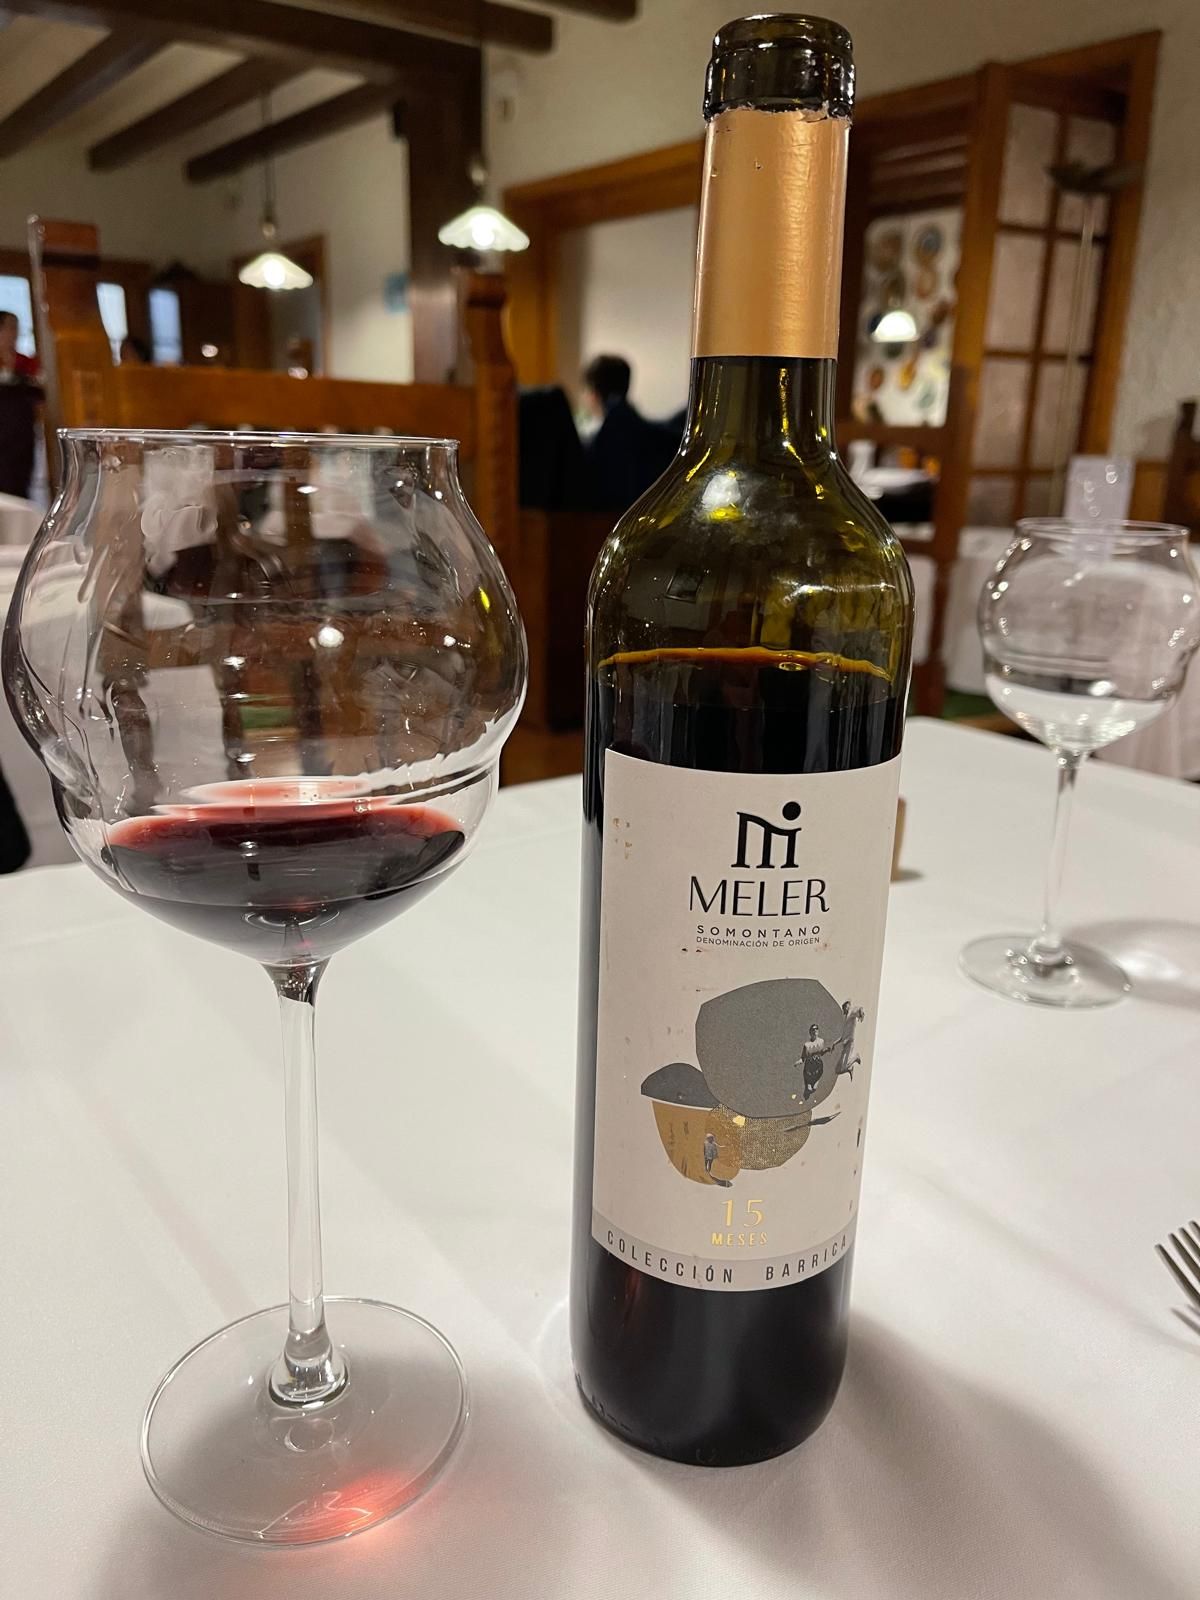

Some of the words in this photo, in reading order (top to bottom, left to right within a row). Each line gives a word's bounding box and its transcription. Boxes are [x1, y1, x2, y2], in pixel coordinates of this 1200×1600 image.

[689, 876, 829, 916] MELER
[696, 936, 768, 947] DENOMINACIÓN
[788, 937, 820, 947] ORIGEN
[697, 925, 820, 937] SOMONTANO
[720, 1199, 764, 1227] 15
[711, 1231, 768, 1246] MESES
[607, 1230, 732, 1283] COLECCIÓN
[765, 1233, 848, 1281] BARRICA
